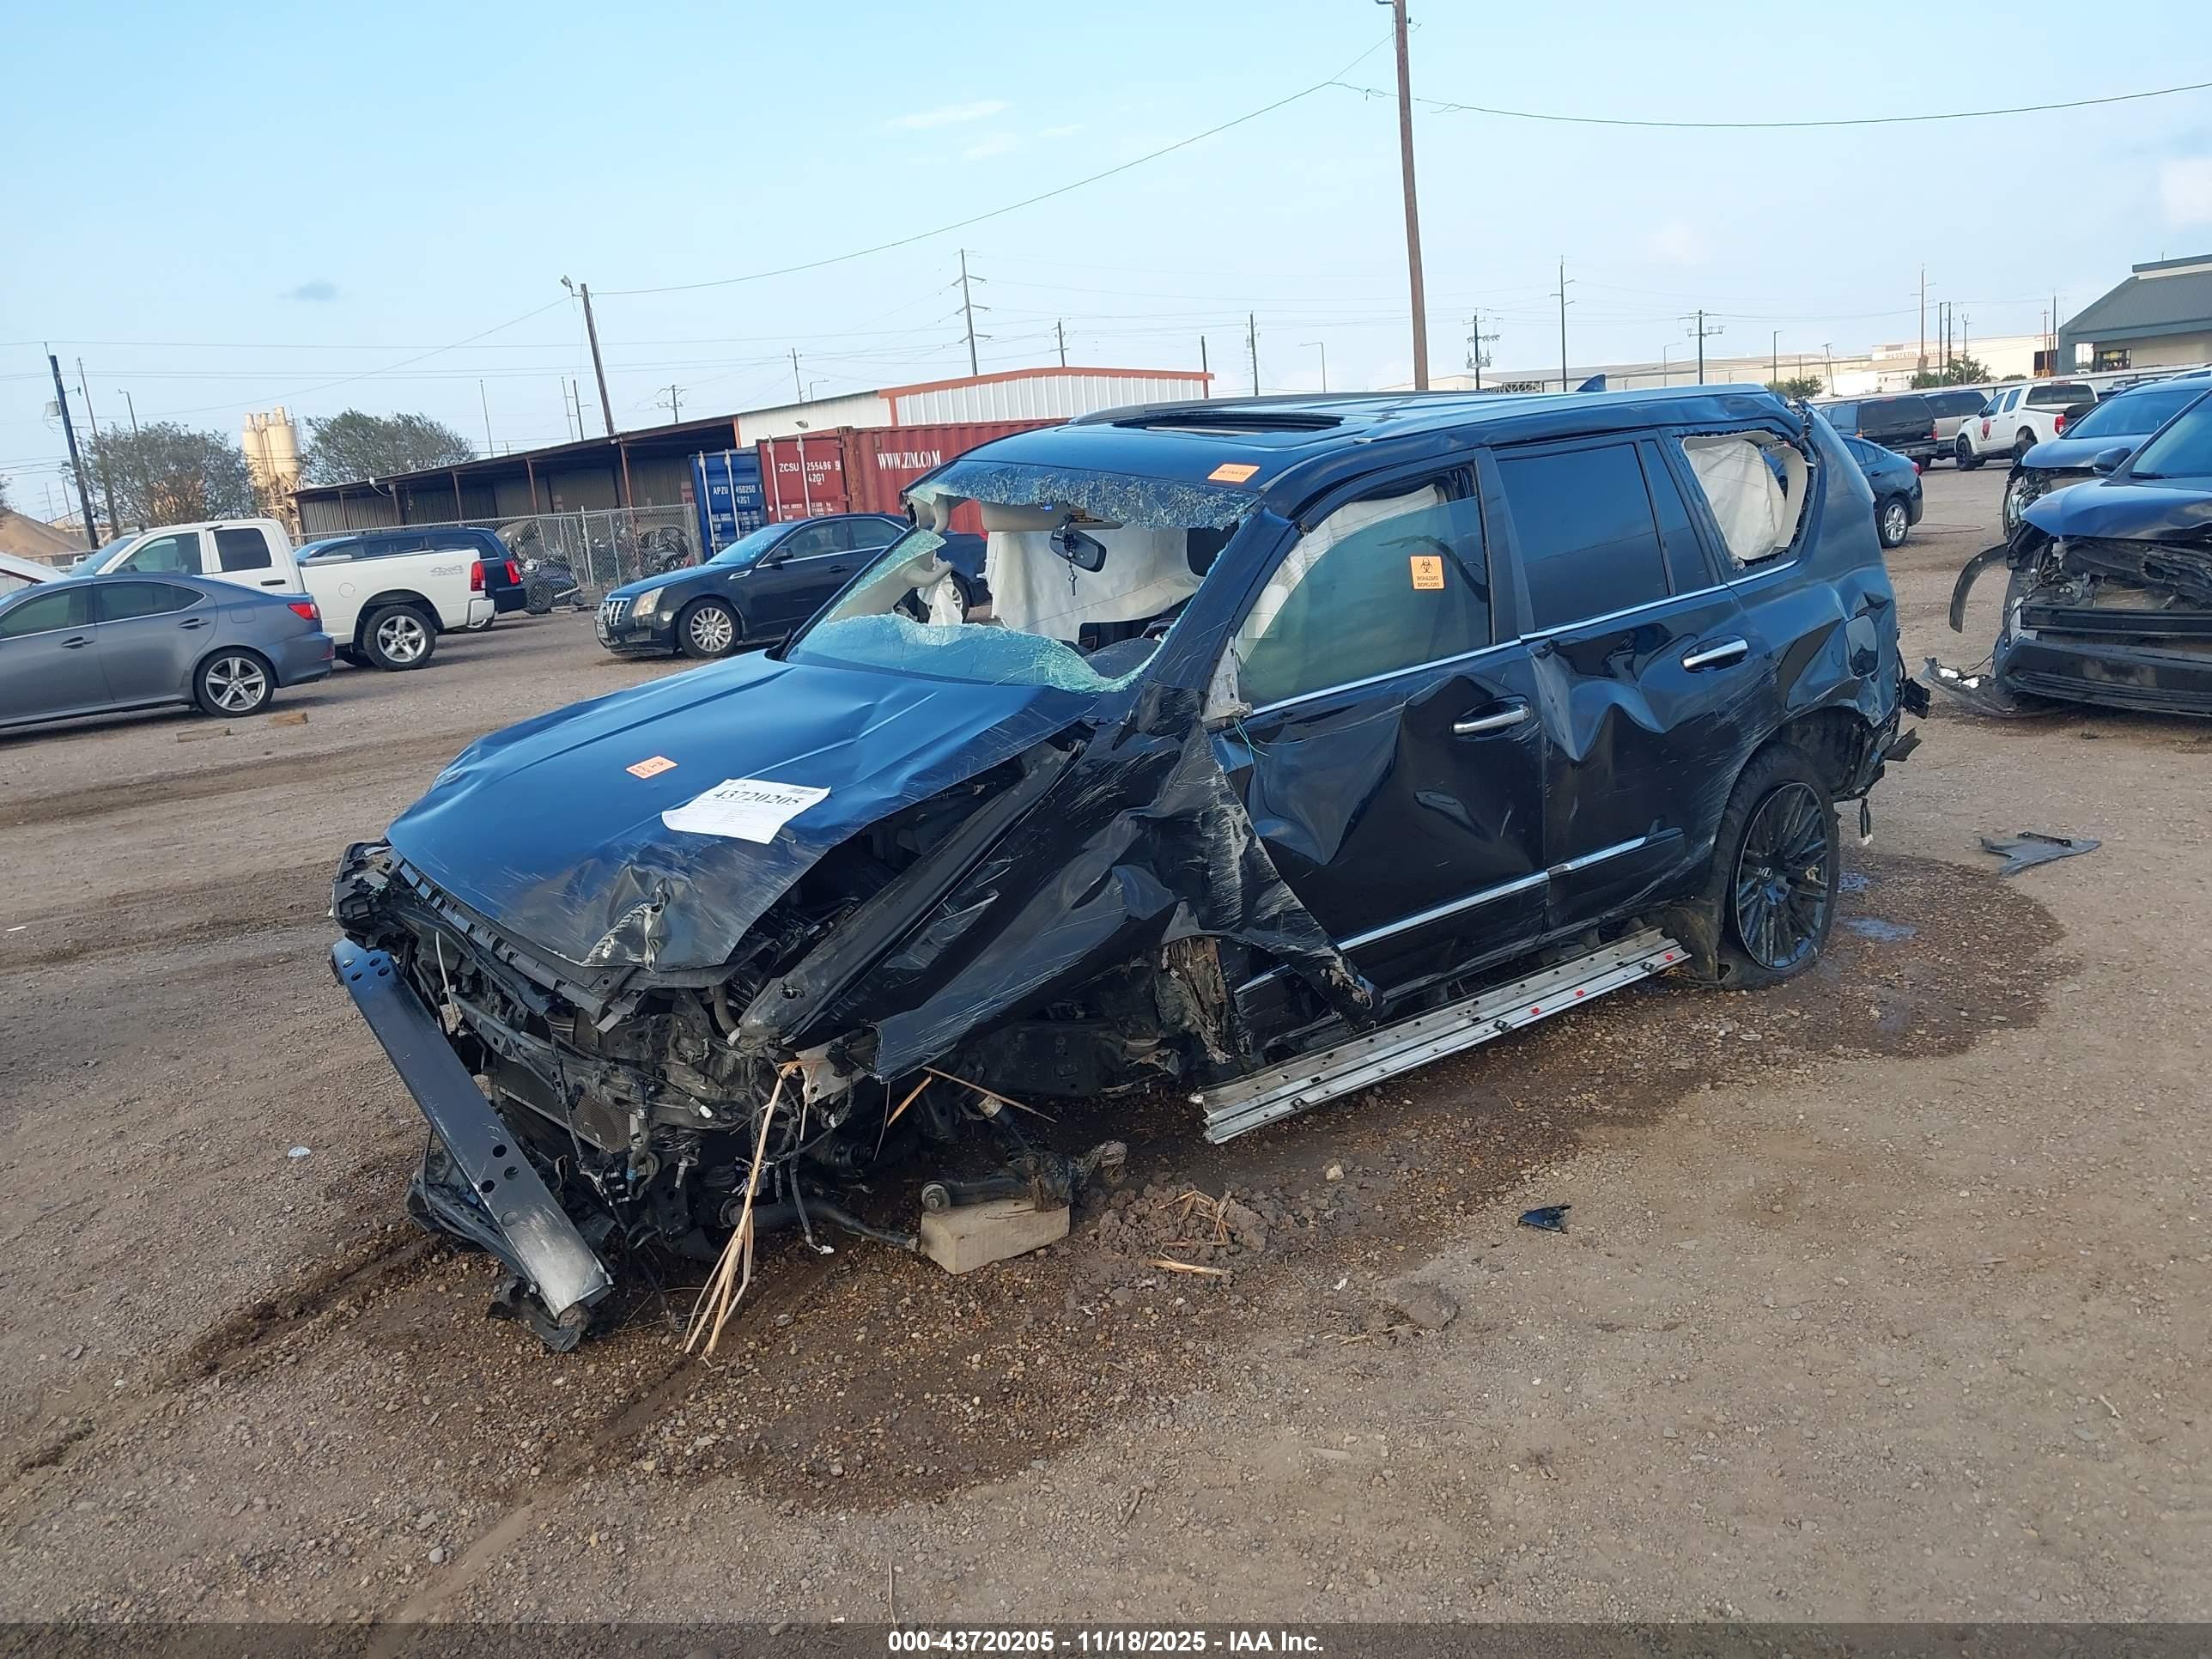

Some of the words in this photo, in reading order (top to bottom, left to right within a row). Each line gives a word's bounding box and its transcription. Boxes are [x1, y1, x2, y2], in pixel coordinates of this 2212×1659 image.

[779, 462, 799, 472] ZCSU
[807, 461, 831, 471] 255496
[808, 473, 825, 483] 42G1
[714, 486, 729, 495] APZU
[714, 789, 805, 805] 43720205
